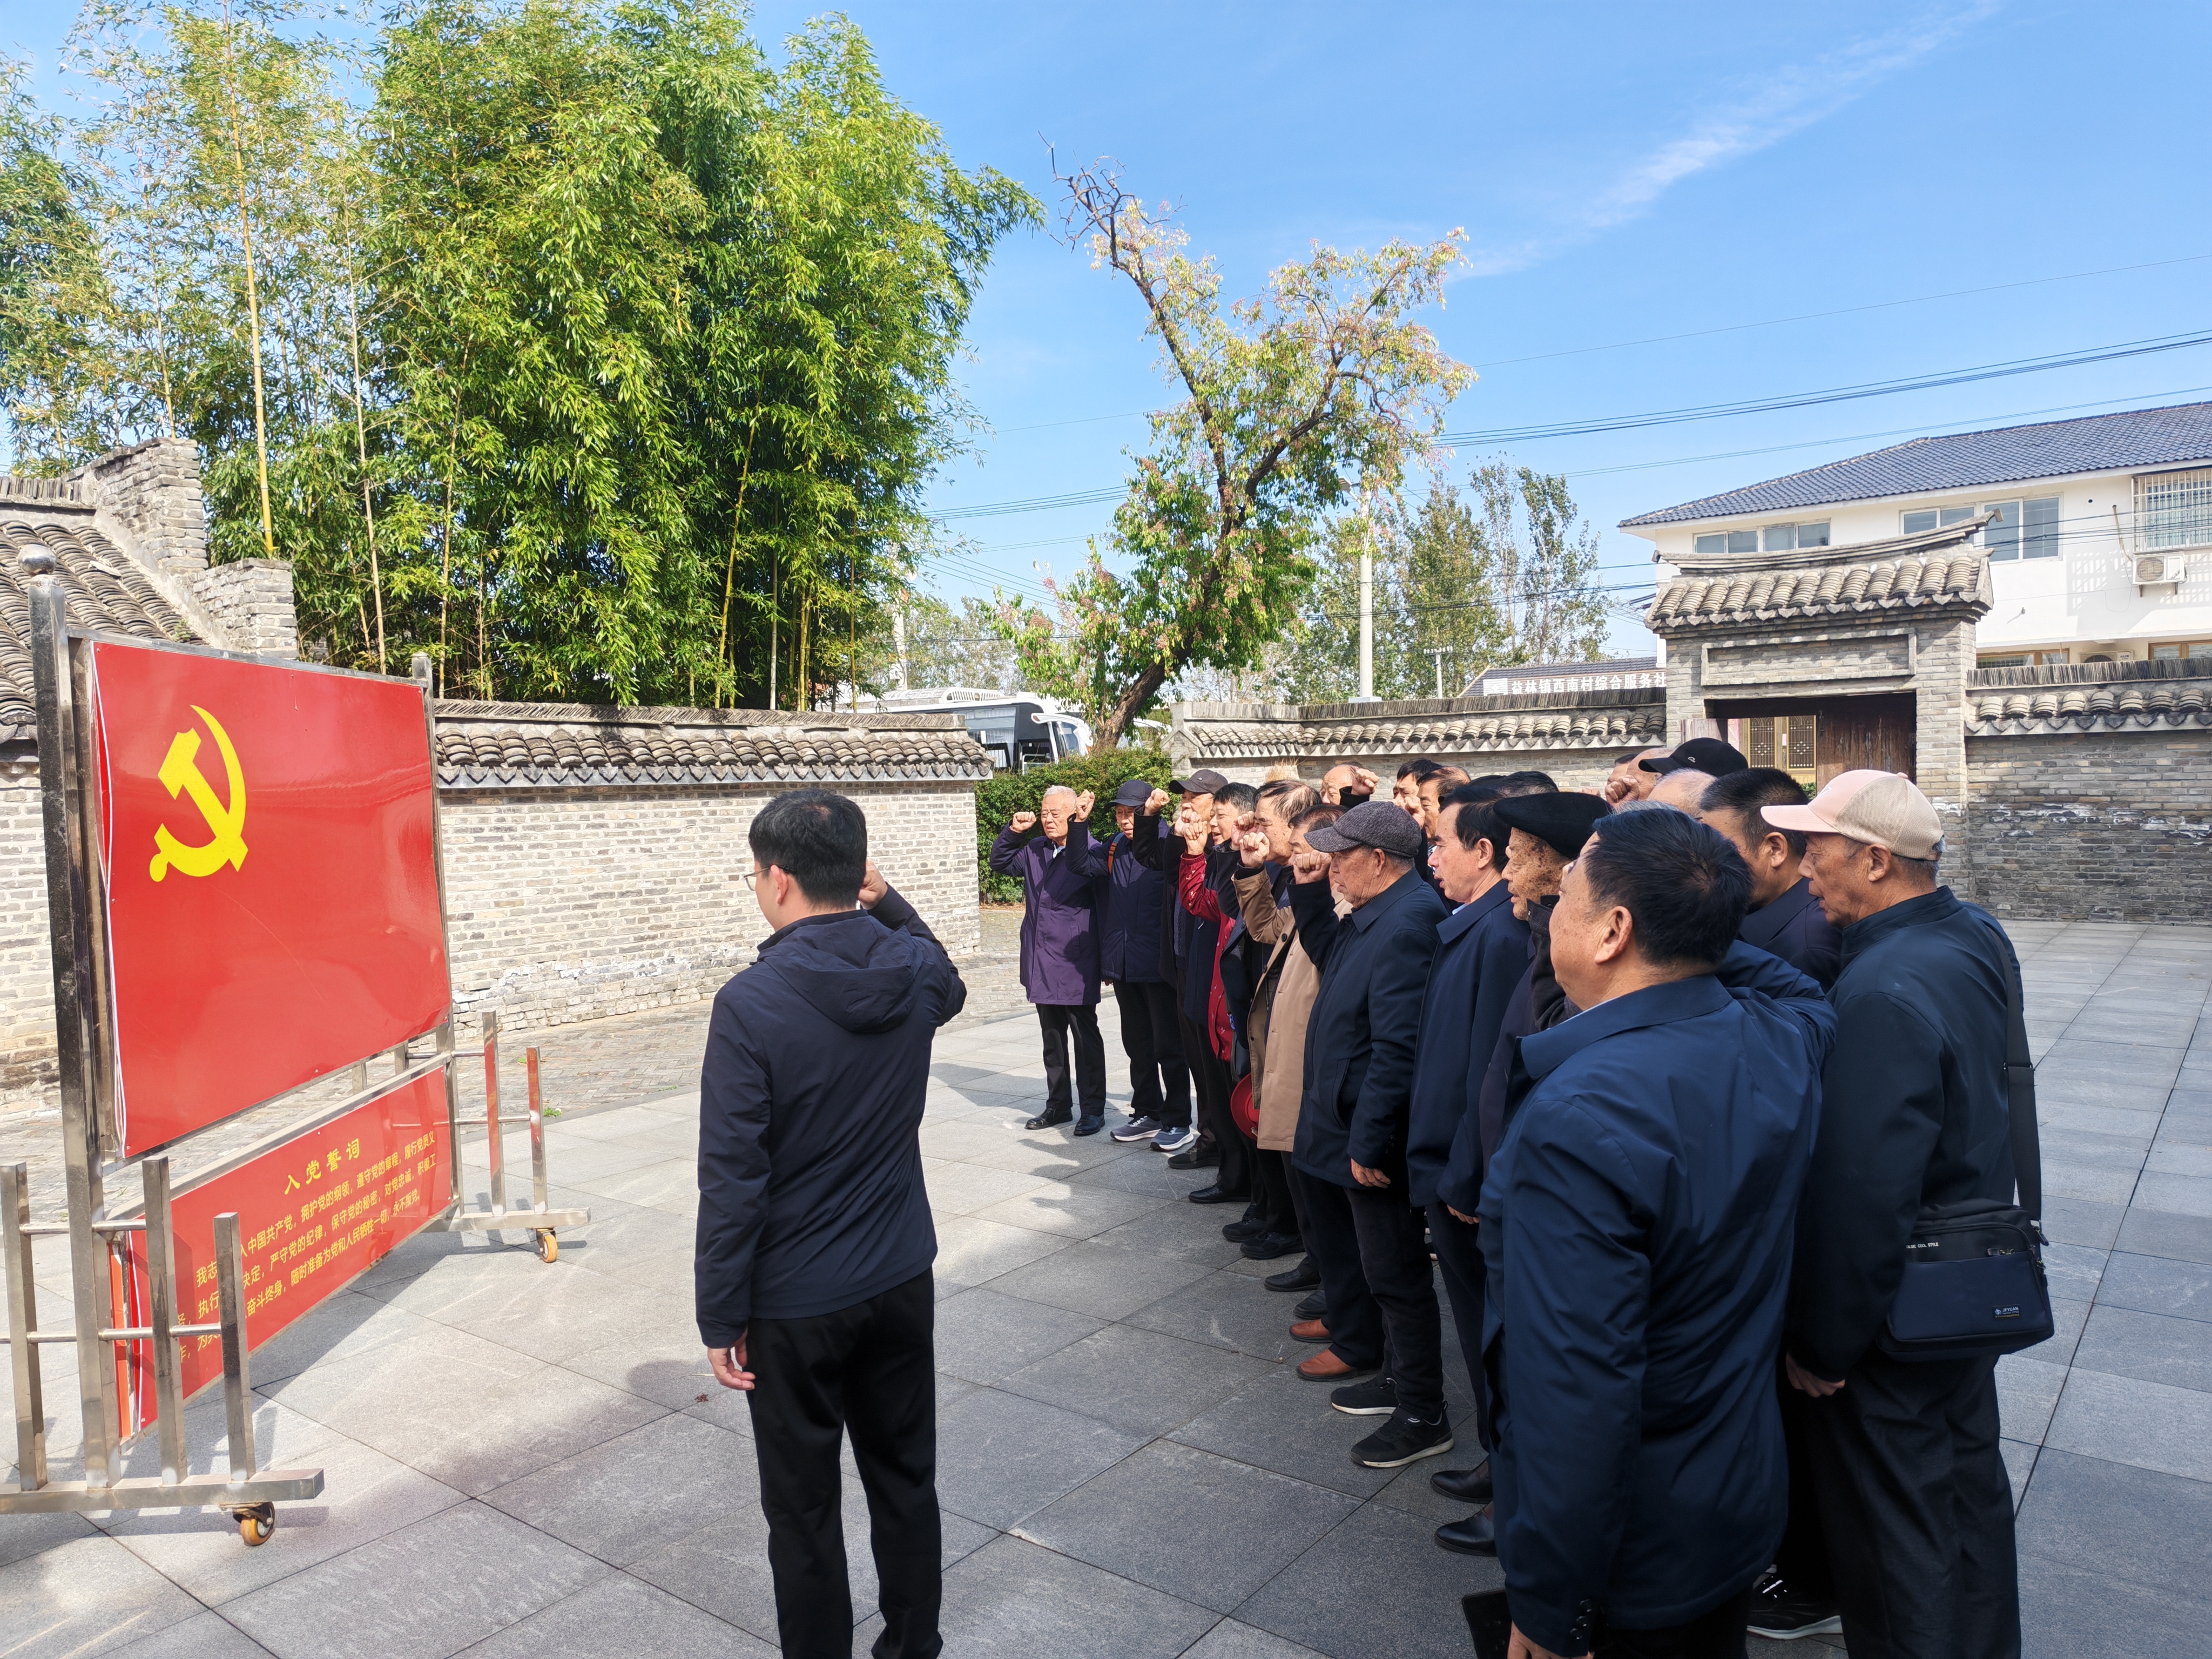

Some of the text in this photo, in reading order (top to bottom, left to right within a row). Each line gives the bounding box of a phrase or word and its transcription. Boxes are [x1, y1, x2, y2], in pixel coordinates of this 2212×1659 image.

[1512, 672, 1667, 694] 益林镇西南村综合服务社
[284, 1138, 360, 1195] 入党誓词
